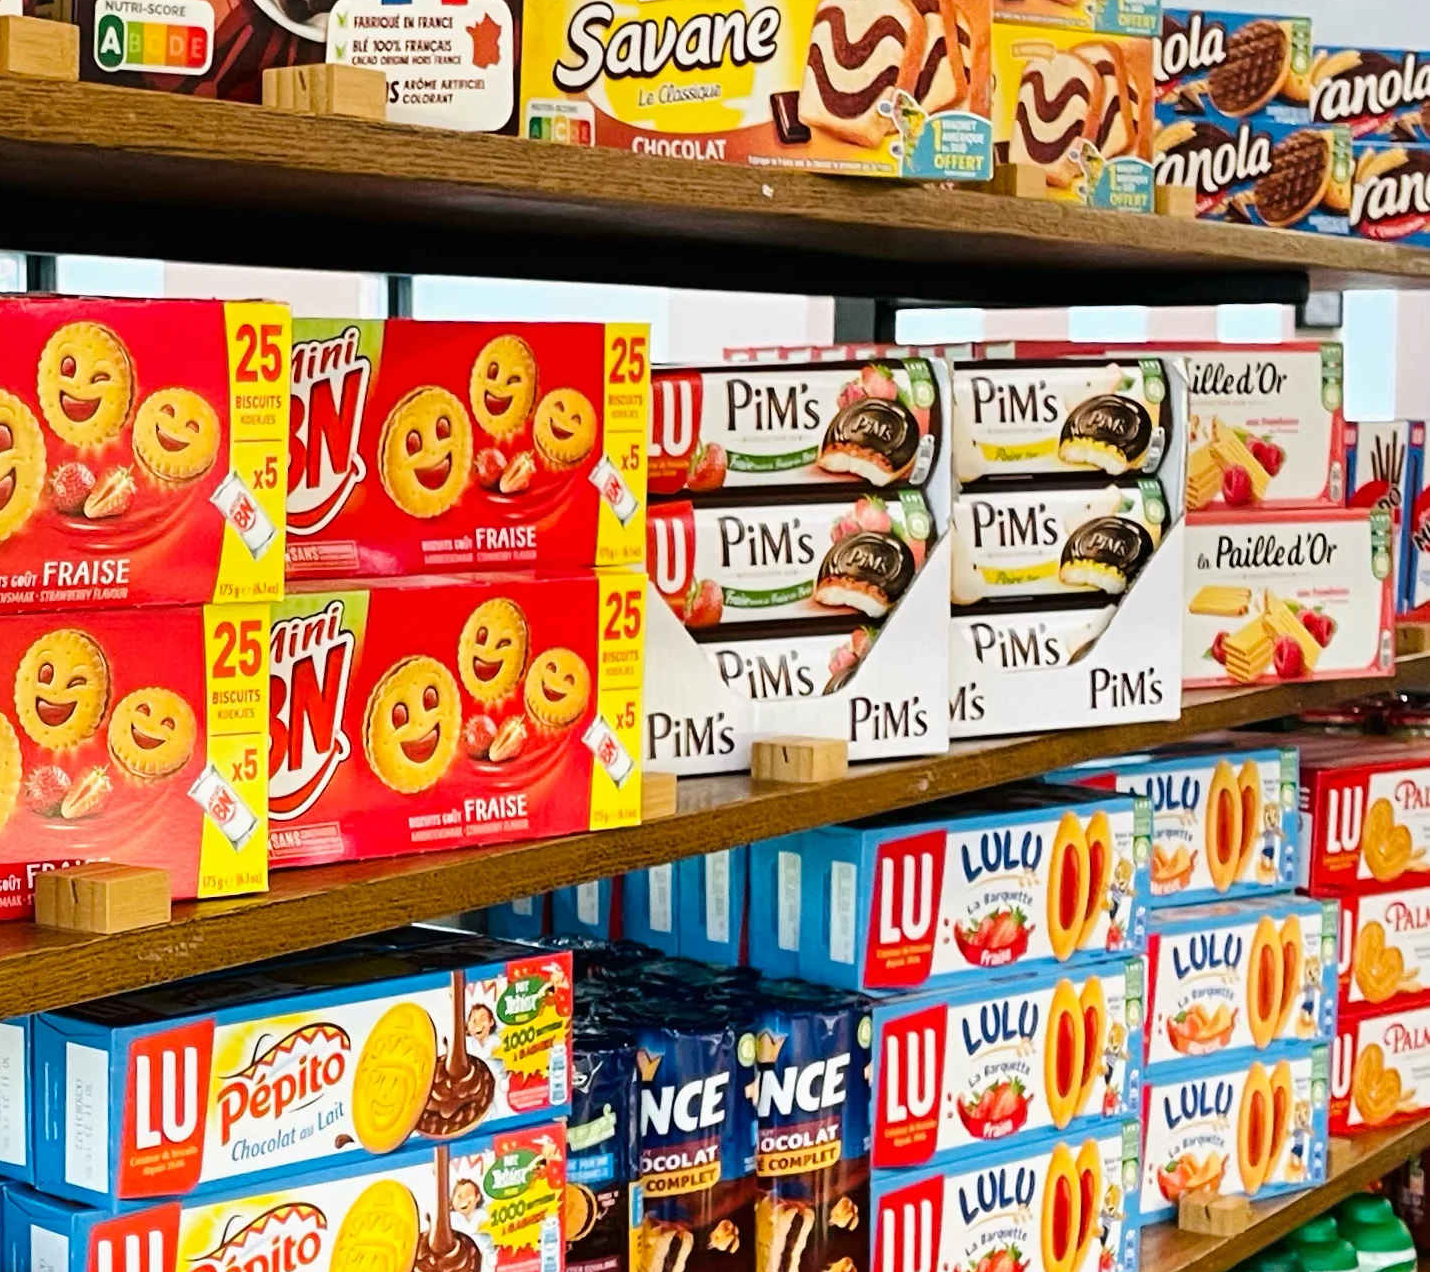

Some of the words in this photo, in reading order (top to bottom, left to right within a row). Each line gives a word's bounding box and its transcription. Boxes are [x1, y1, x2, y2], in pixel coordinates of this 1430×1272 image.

[104, 0, 187, 18] NUTRI-SCORE
[553, 2, 781, 92] Savane
[1310, 53, 1430, 122] ranola
[631, 136, 727, 161] CHOCOLAT
[234, 323, 283, 384] 25
[610, 336, 644, 383] 25
[234, 394, 282, 411] BISCUITS
[726, 378, 821, 432] PiM's
[970, 375, 1059, 425] PiM's
[252, 456, 279, 490] x5
[475, 526, 537, 550] FRAISE
[718, 515, 815, 568] PiM's
[971, 501, 1059, 549] PiM's
[42, 558, 130, 587] FRAISE
[604, 592, 641, 641] 25
[212, 619, 263, 679] 25
[1090, 666, 1164, 712] PiM's
[646, 710, 735, 762] PiM's
[848, 694, 929, 743] PiM's
[464, 793, 527, 820] FRAISE
[1326, 786, 1365, 854] LU
[961, 830, 1043, 882] LULU
[879, 852, 933, 945] LU
[1173, 932, 1243, 980] LULU
[503, 1026, 537, 1053] 1000
[962, 999, 1039, 1055] LULU
[136, 1045, 199, 1151] LU
[885, 1028, 937, 1119] LU
[217, 1053, 346, 1147] Pépito
[1163, 1081, 1233, 1129] LULU
[231, 1127, 296, 1164] Chocolat
[299, 1124, 314, 1139] au
[317, 1100, 345, 1133] Lait
[760, 1124, 840, 1152] OCOLAT
[768, 1146, 837, 1172] COMPLET
[959, 1167, 1036, 1224] LULU
